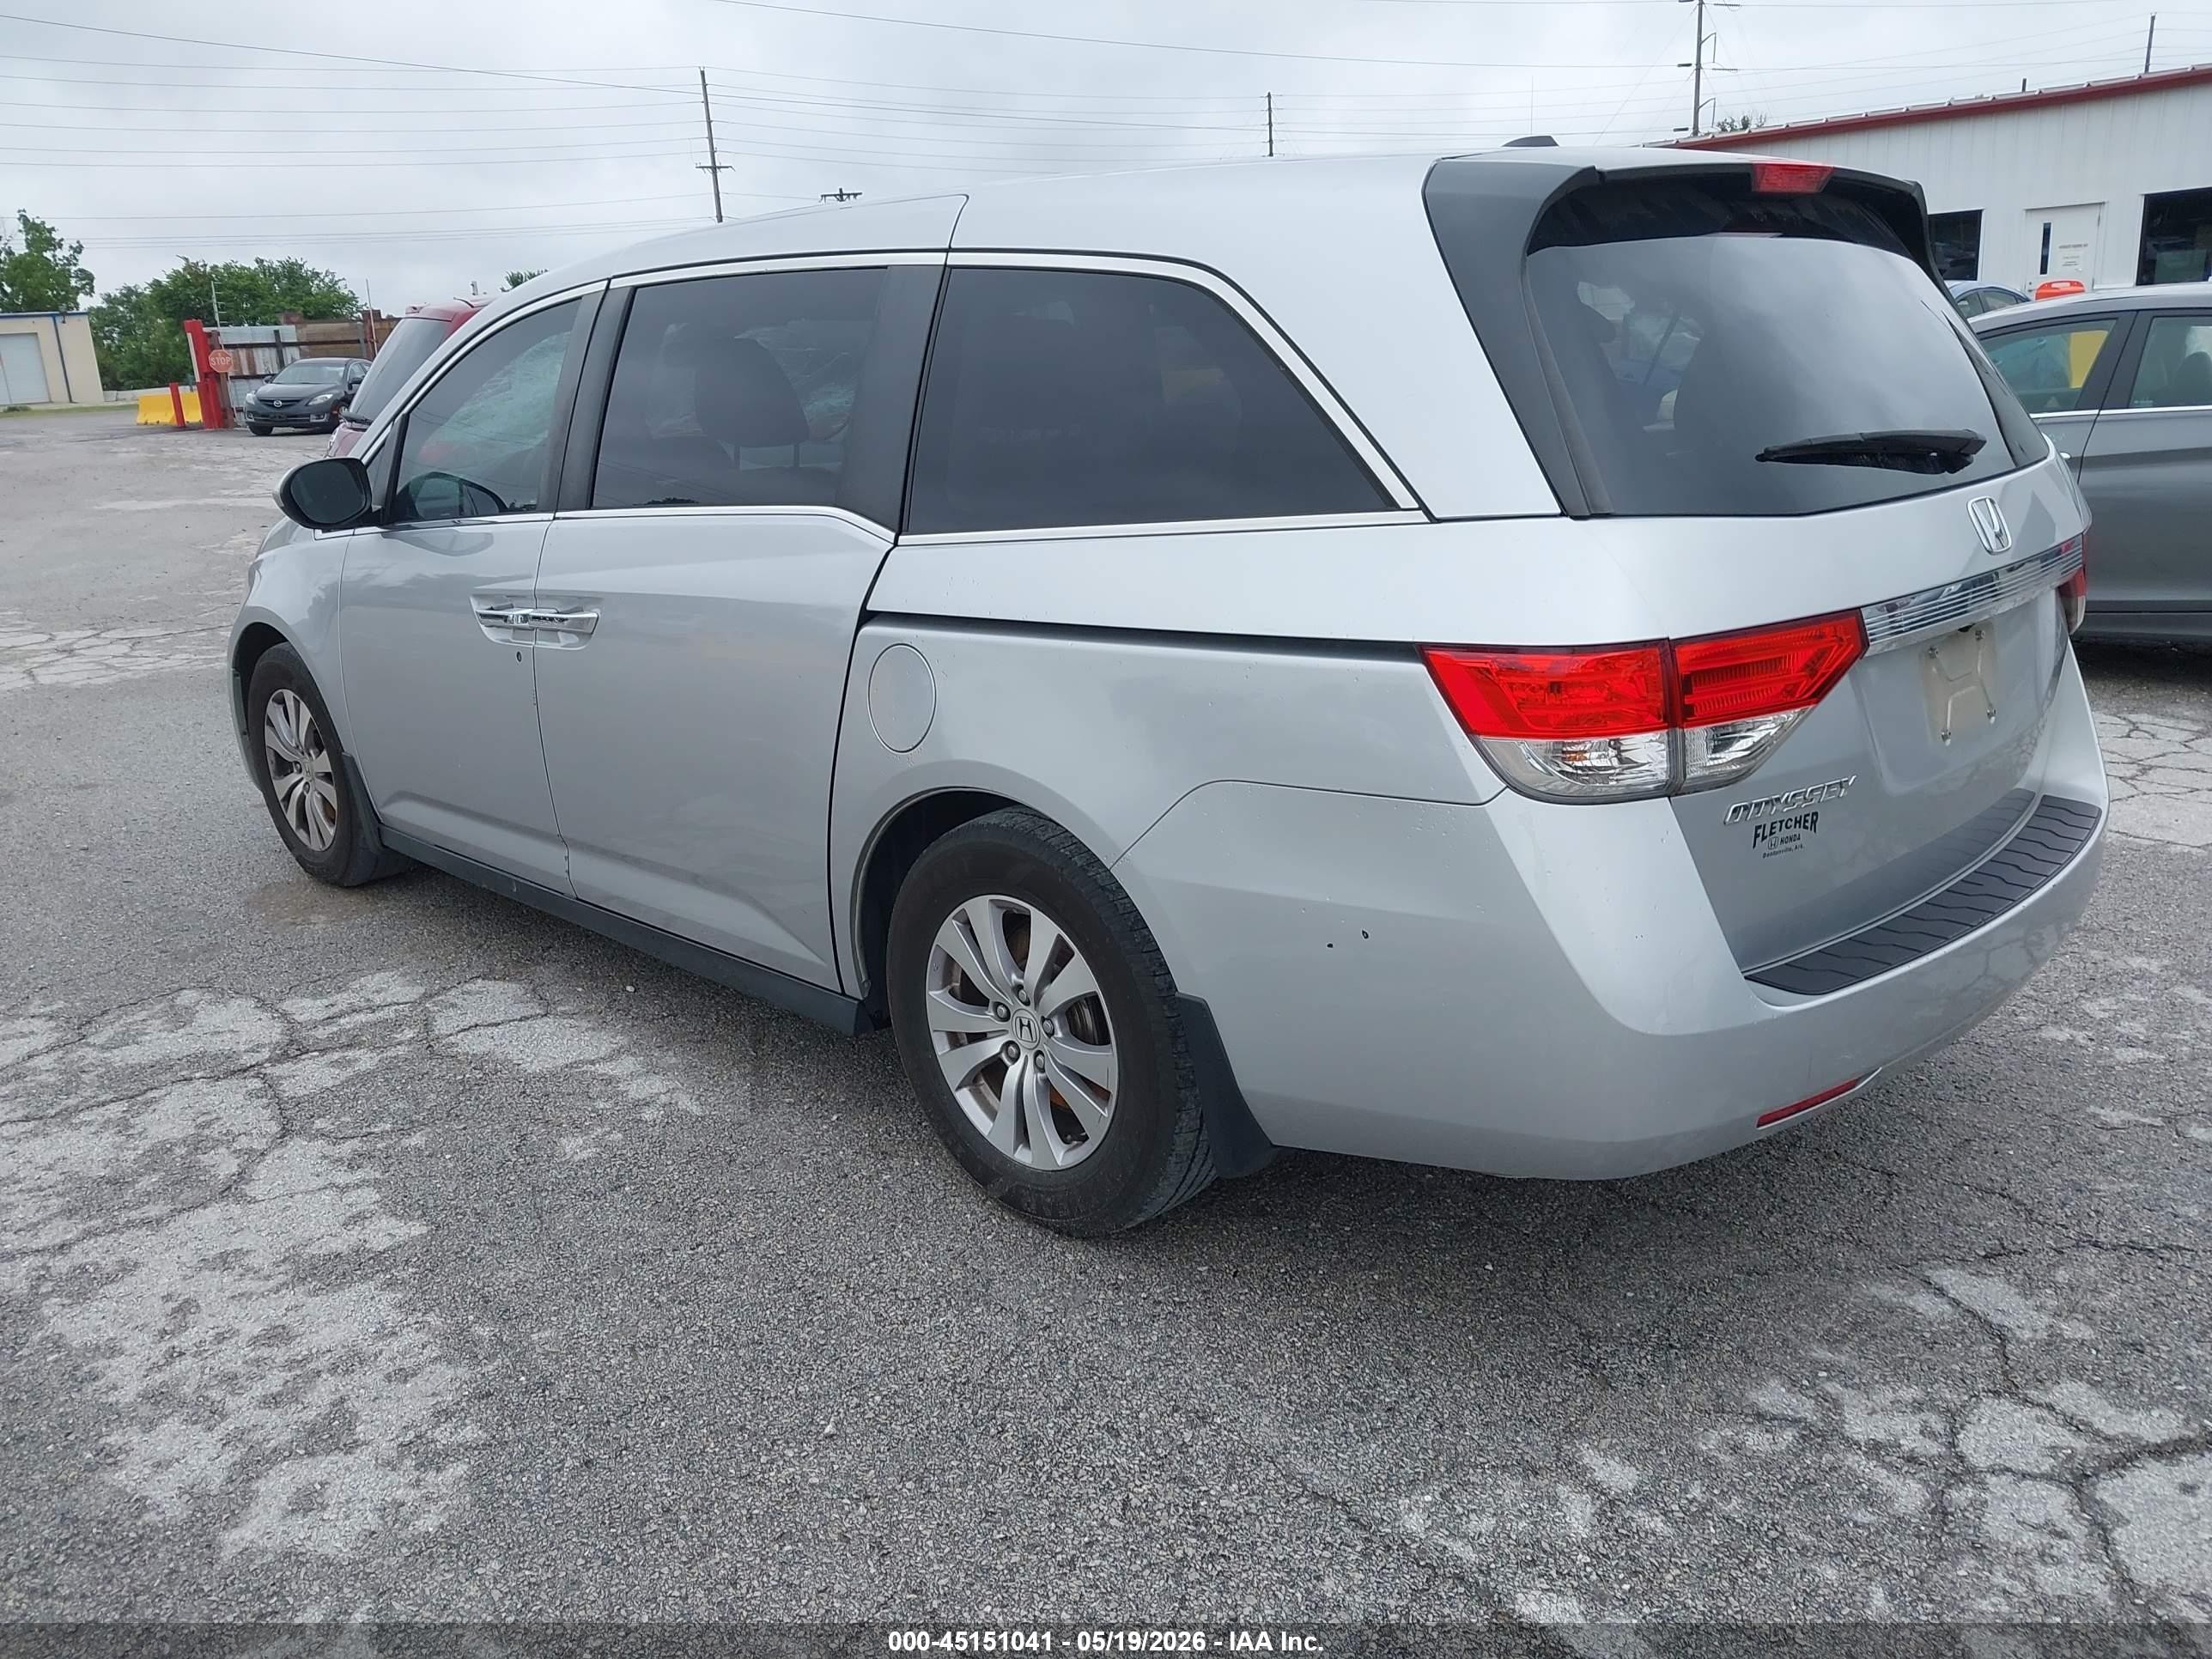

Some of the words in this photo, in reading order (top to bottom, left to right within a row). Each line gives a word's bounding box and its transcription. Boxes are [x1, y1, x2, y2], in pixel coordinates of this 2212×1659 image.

[210, 356, 231, 366] STOP
[1723, 775, 1857, 825] ODYSSEY
[1752, 811, 1819, 849] FLETCHER
[1779, 833, 1802, 846] HONDA
